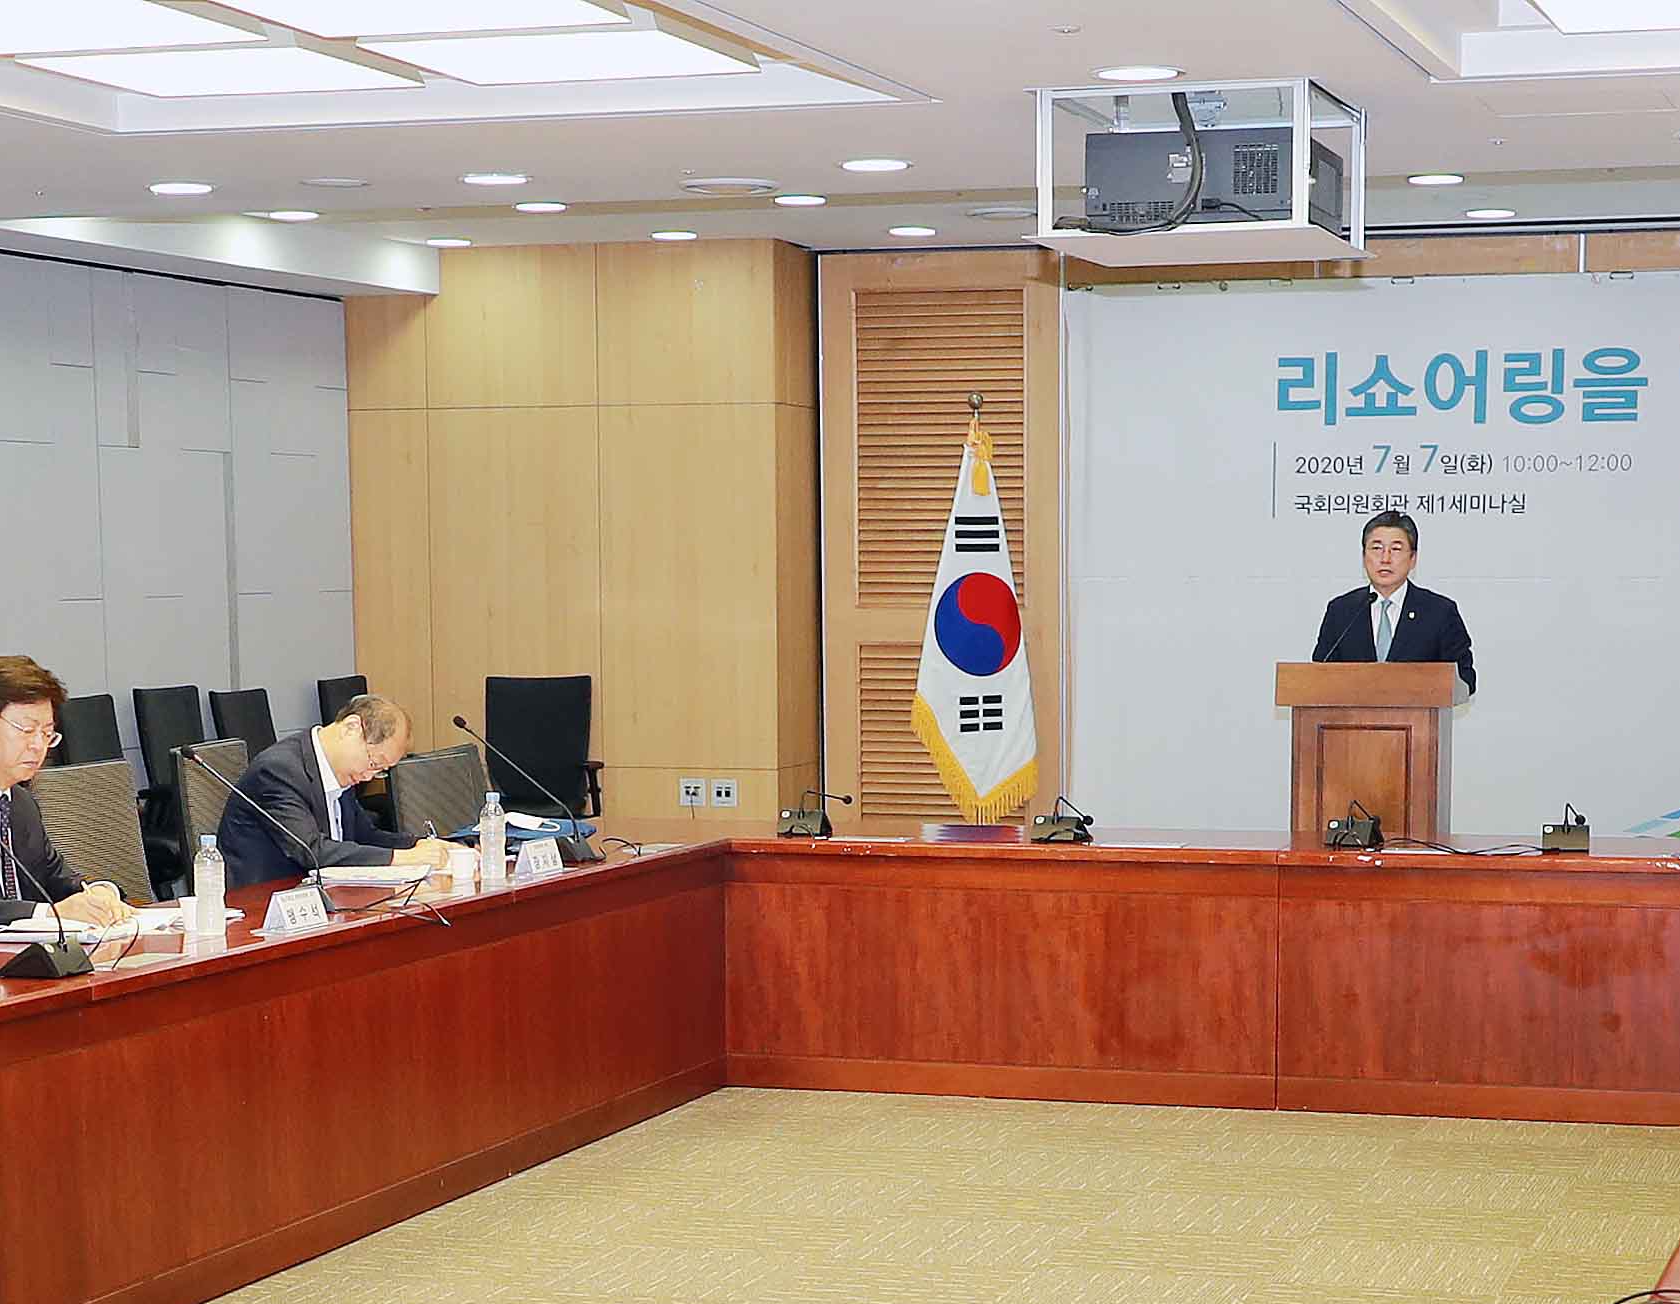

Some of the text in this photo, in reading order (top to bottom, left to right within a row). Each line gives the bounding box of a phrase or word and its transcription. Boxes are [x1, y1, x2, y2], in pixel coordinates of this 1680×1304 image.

[1276, 346, 1649, 426] 리쇼어링을
[1294, 444, 1633, 475] 2020년 7월 7일(화) 10:00~12:00
[1294, 493, 1526, 515] 국회의원회관 제1세미나실
